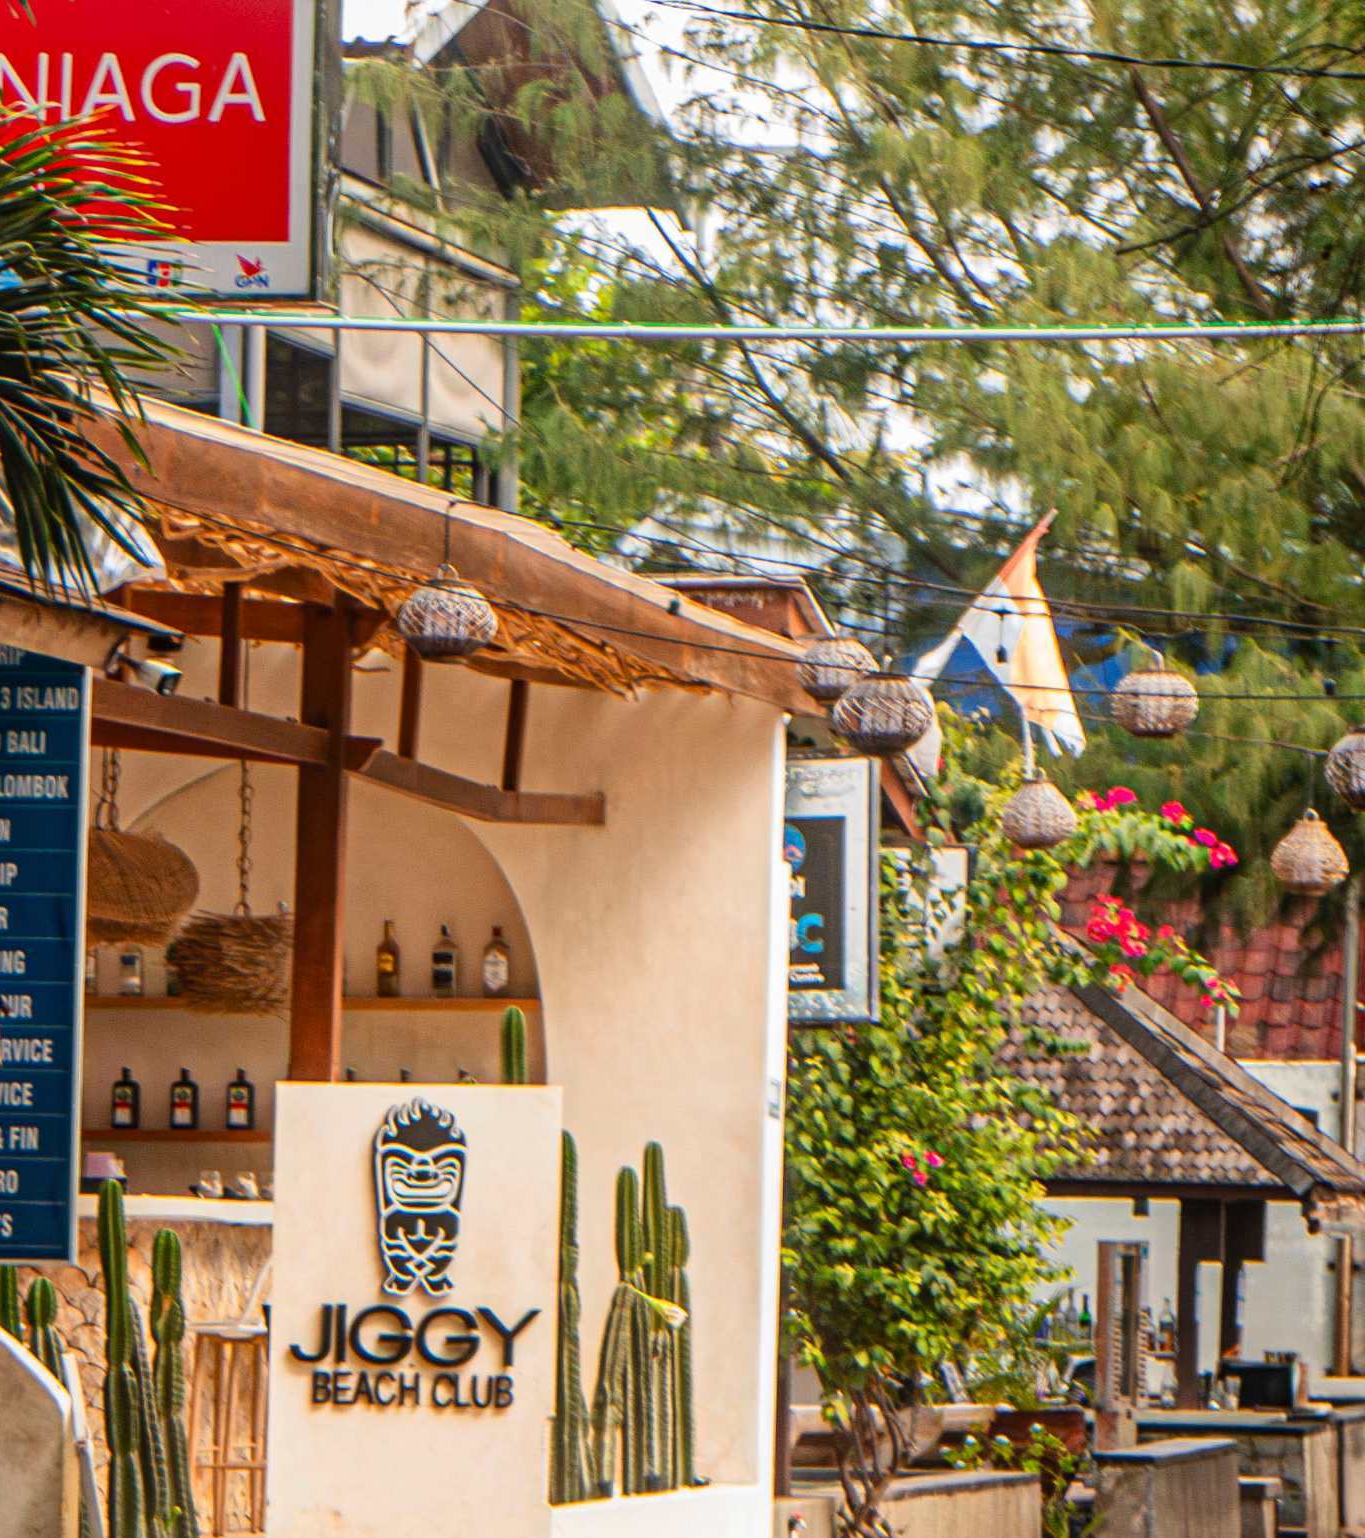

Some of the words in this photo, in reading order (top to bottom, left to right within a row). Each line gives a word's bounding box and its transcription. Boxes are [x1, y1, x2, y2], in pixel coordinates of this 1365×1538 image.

[0, 687, 12, 710] 3
[16, 686, 79, 710] ISLAND
[7, 731, 46, 754] BALI
[9, 1126, 38, 1150] FIN
[288, 1303, 542, 1367] JIGGY
[311, 1371, 420, 1406] BEACH
[431, 1374, 515, 1408] CLUB
